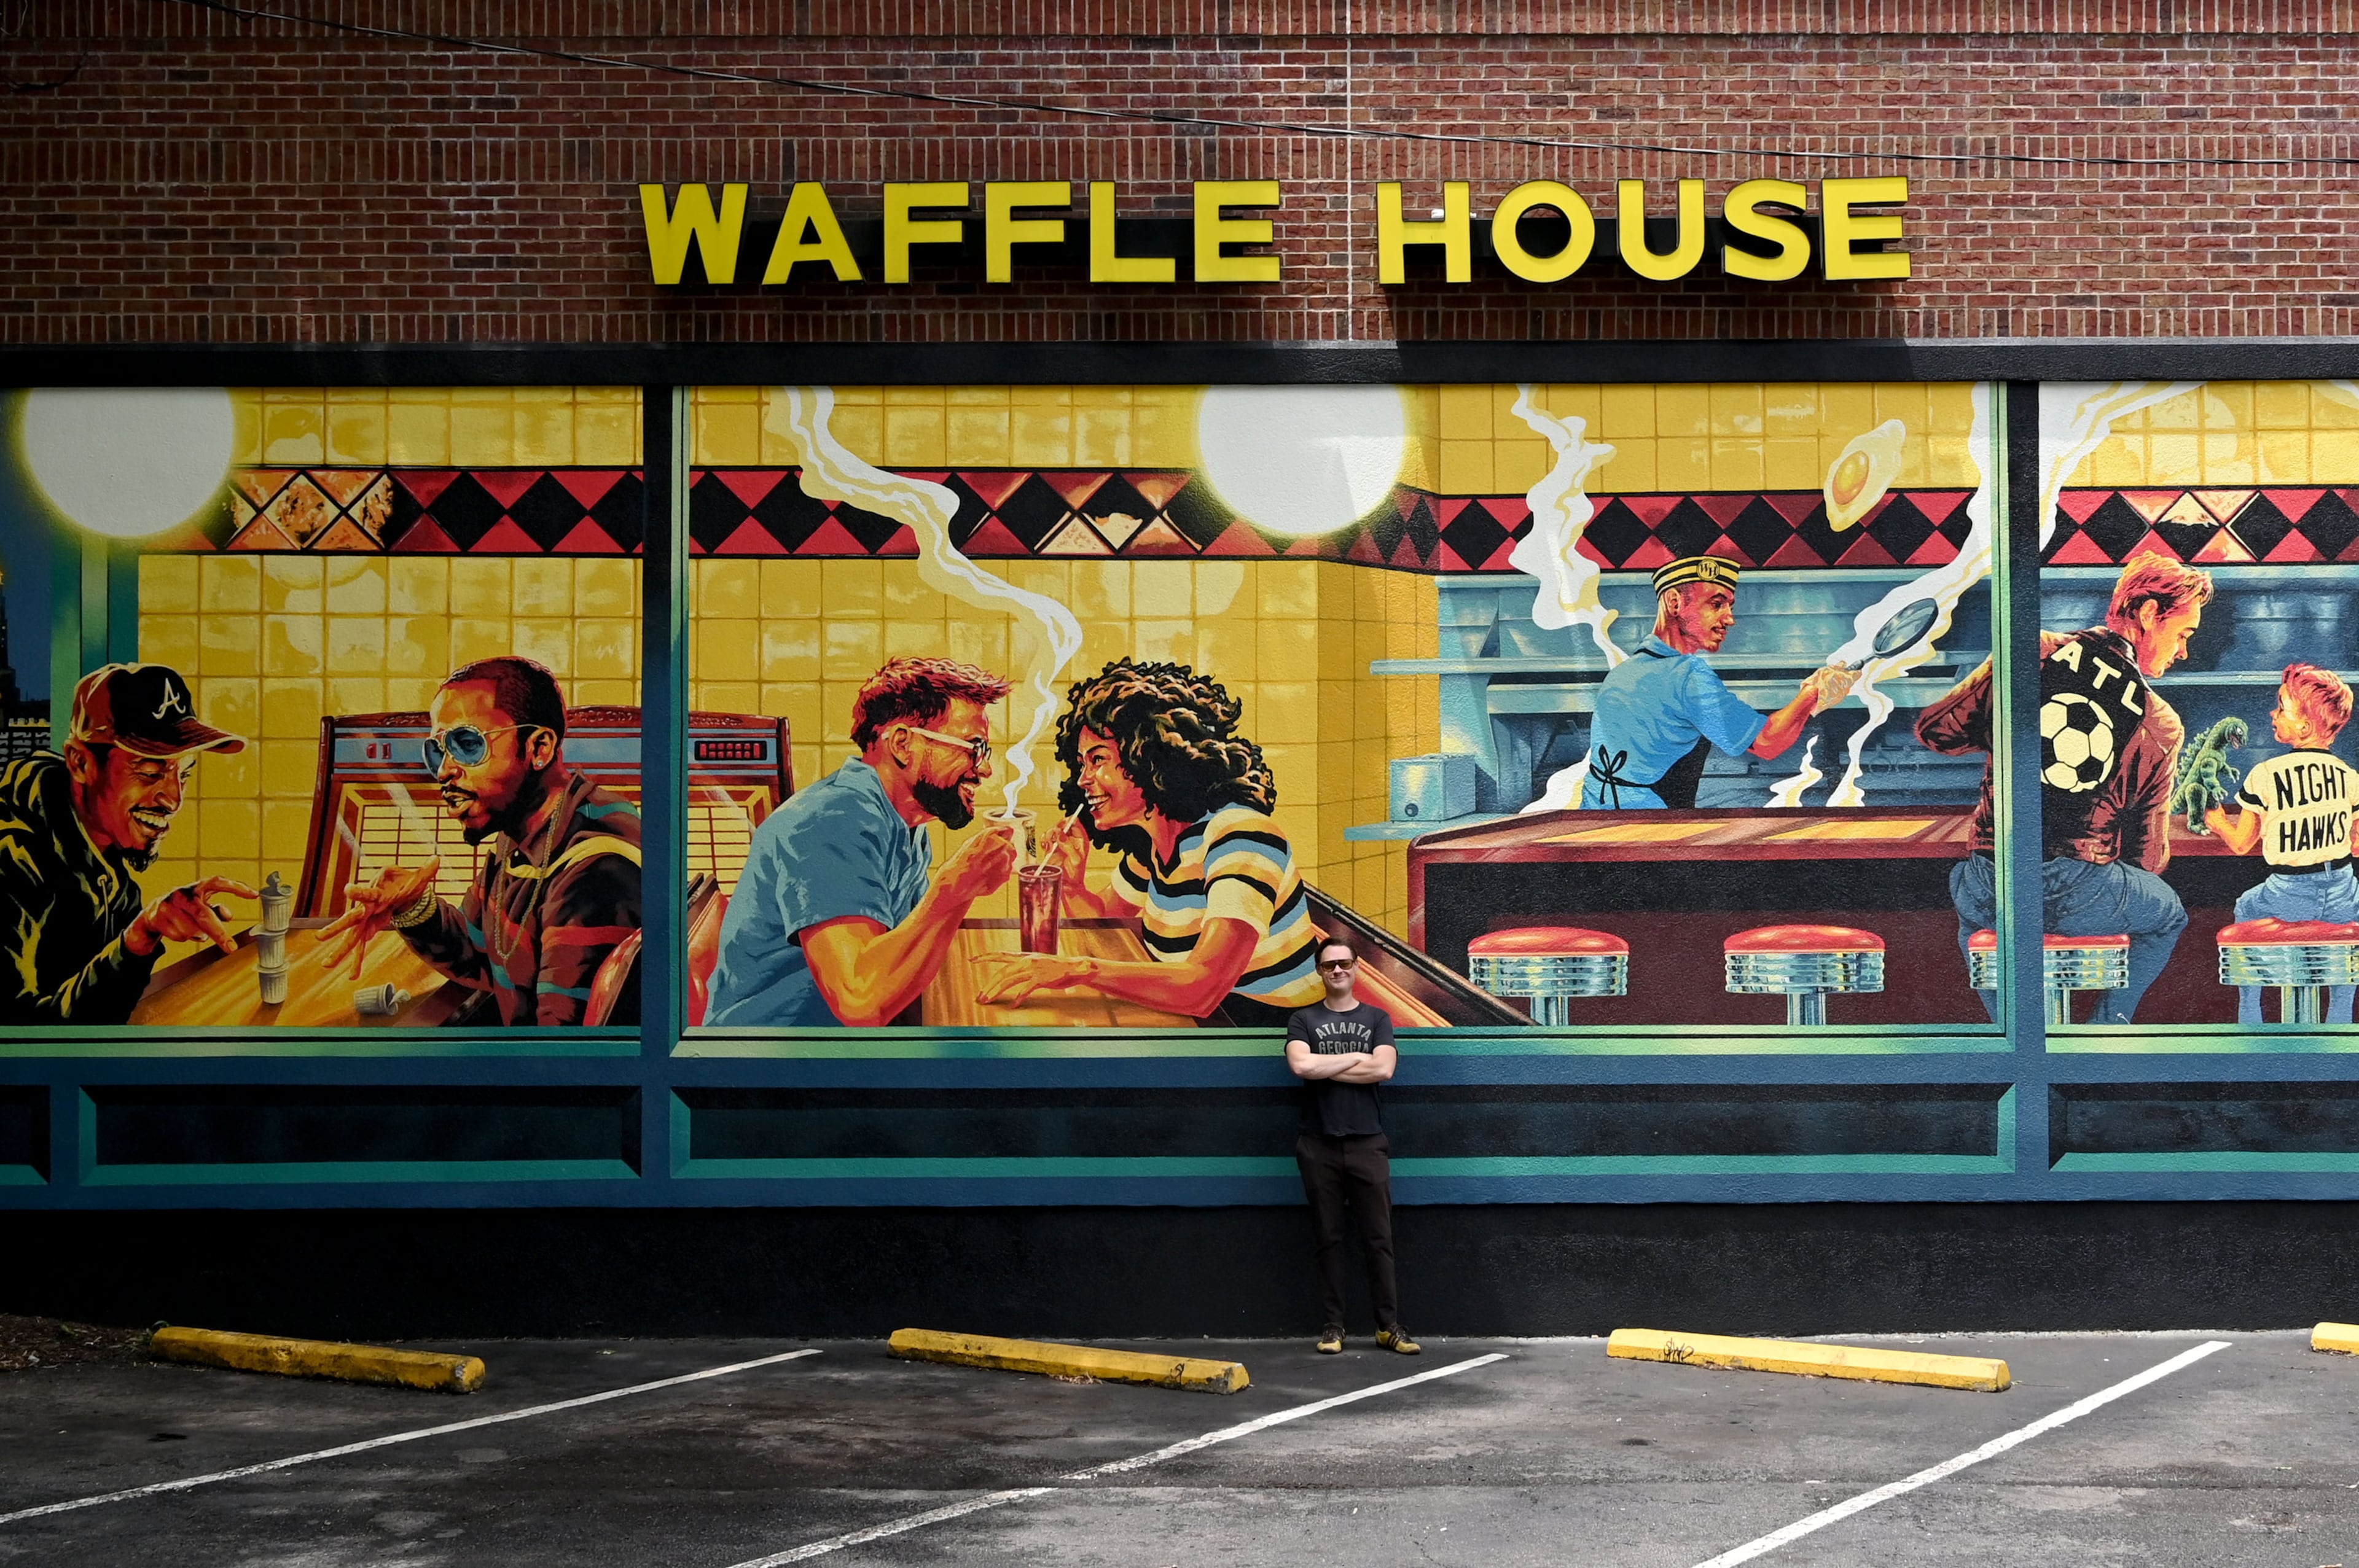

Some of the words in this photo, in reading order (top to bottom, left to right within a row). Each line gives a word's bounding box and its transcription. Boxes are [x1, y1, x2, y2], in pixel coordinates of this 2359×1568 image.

[639, 180, 1281, 284] WAFFLE
[1377, 176, 1912, 284] HOUSE
[152, 677, 186, 719] A
[2051, 641, 2143, 716] ATL
[2274, 763, 2347, 810] NIGHT
[2280, 811, 2347, 852] HAWKS
[1315, 1022, 1371, 1041] ATLANTA
[1318, 1040, 1369, 1055] GEORGIA
